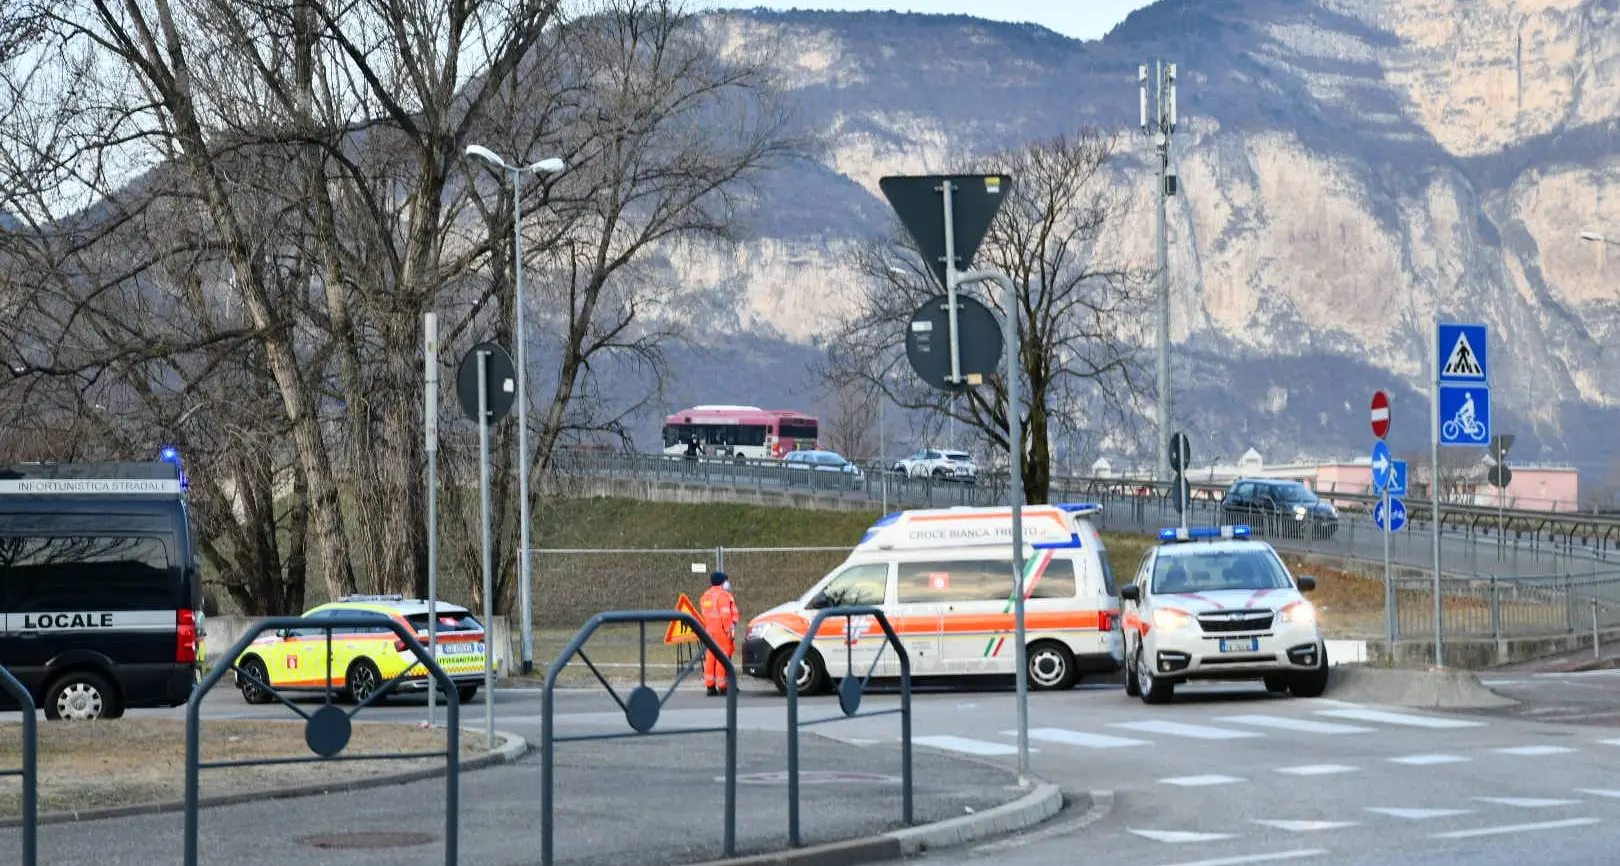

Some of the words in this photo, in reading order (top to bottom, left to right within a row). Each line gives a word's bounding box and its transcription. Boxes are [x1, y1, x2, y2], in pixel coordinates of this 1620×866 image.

[908, 530, 945, 540] CROCE
[949, 528, 991, 539] BIANCA
[995, 527, 1038, 537] TRETO
[24, 613, 113, 629] LOCALE
